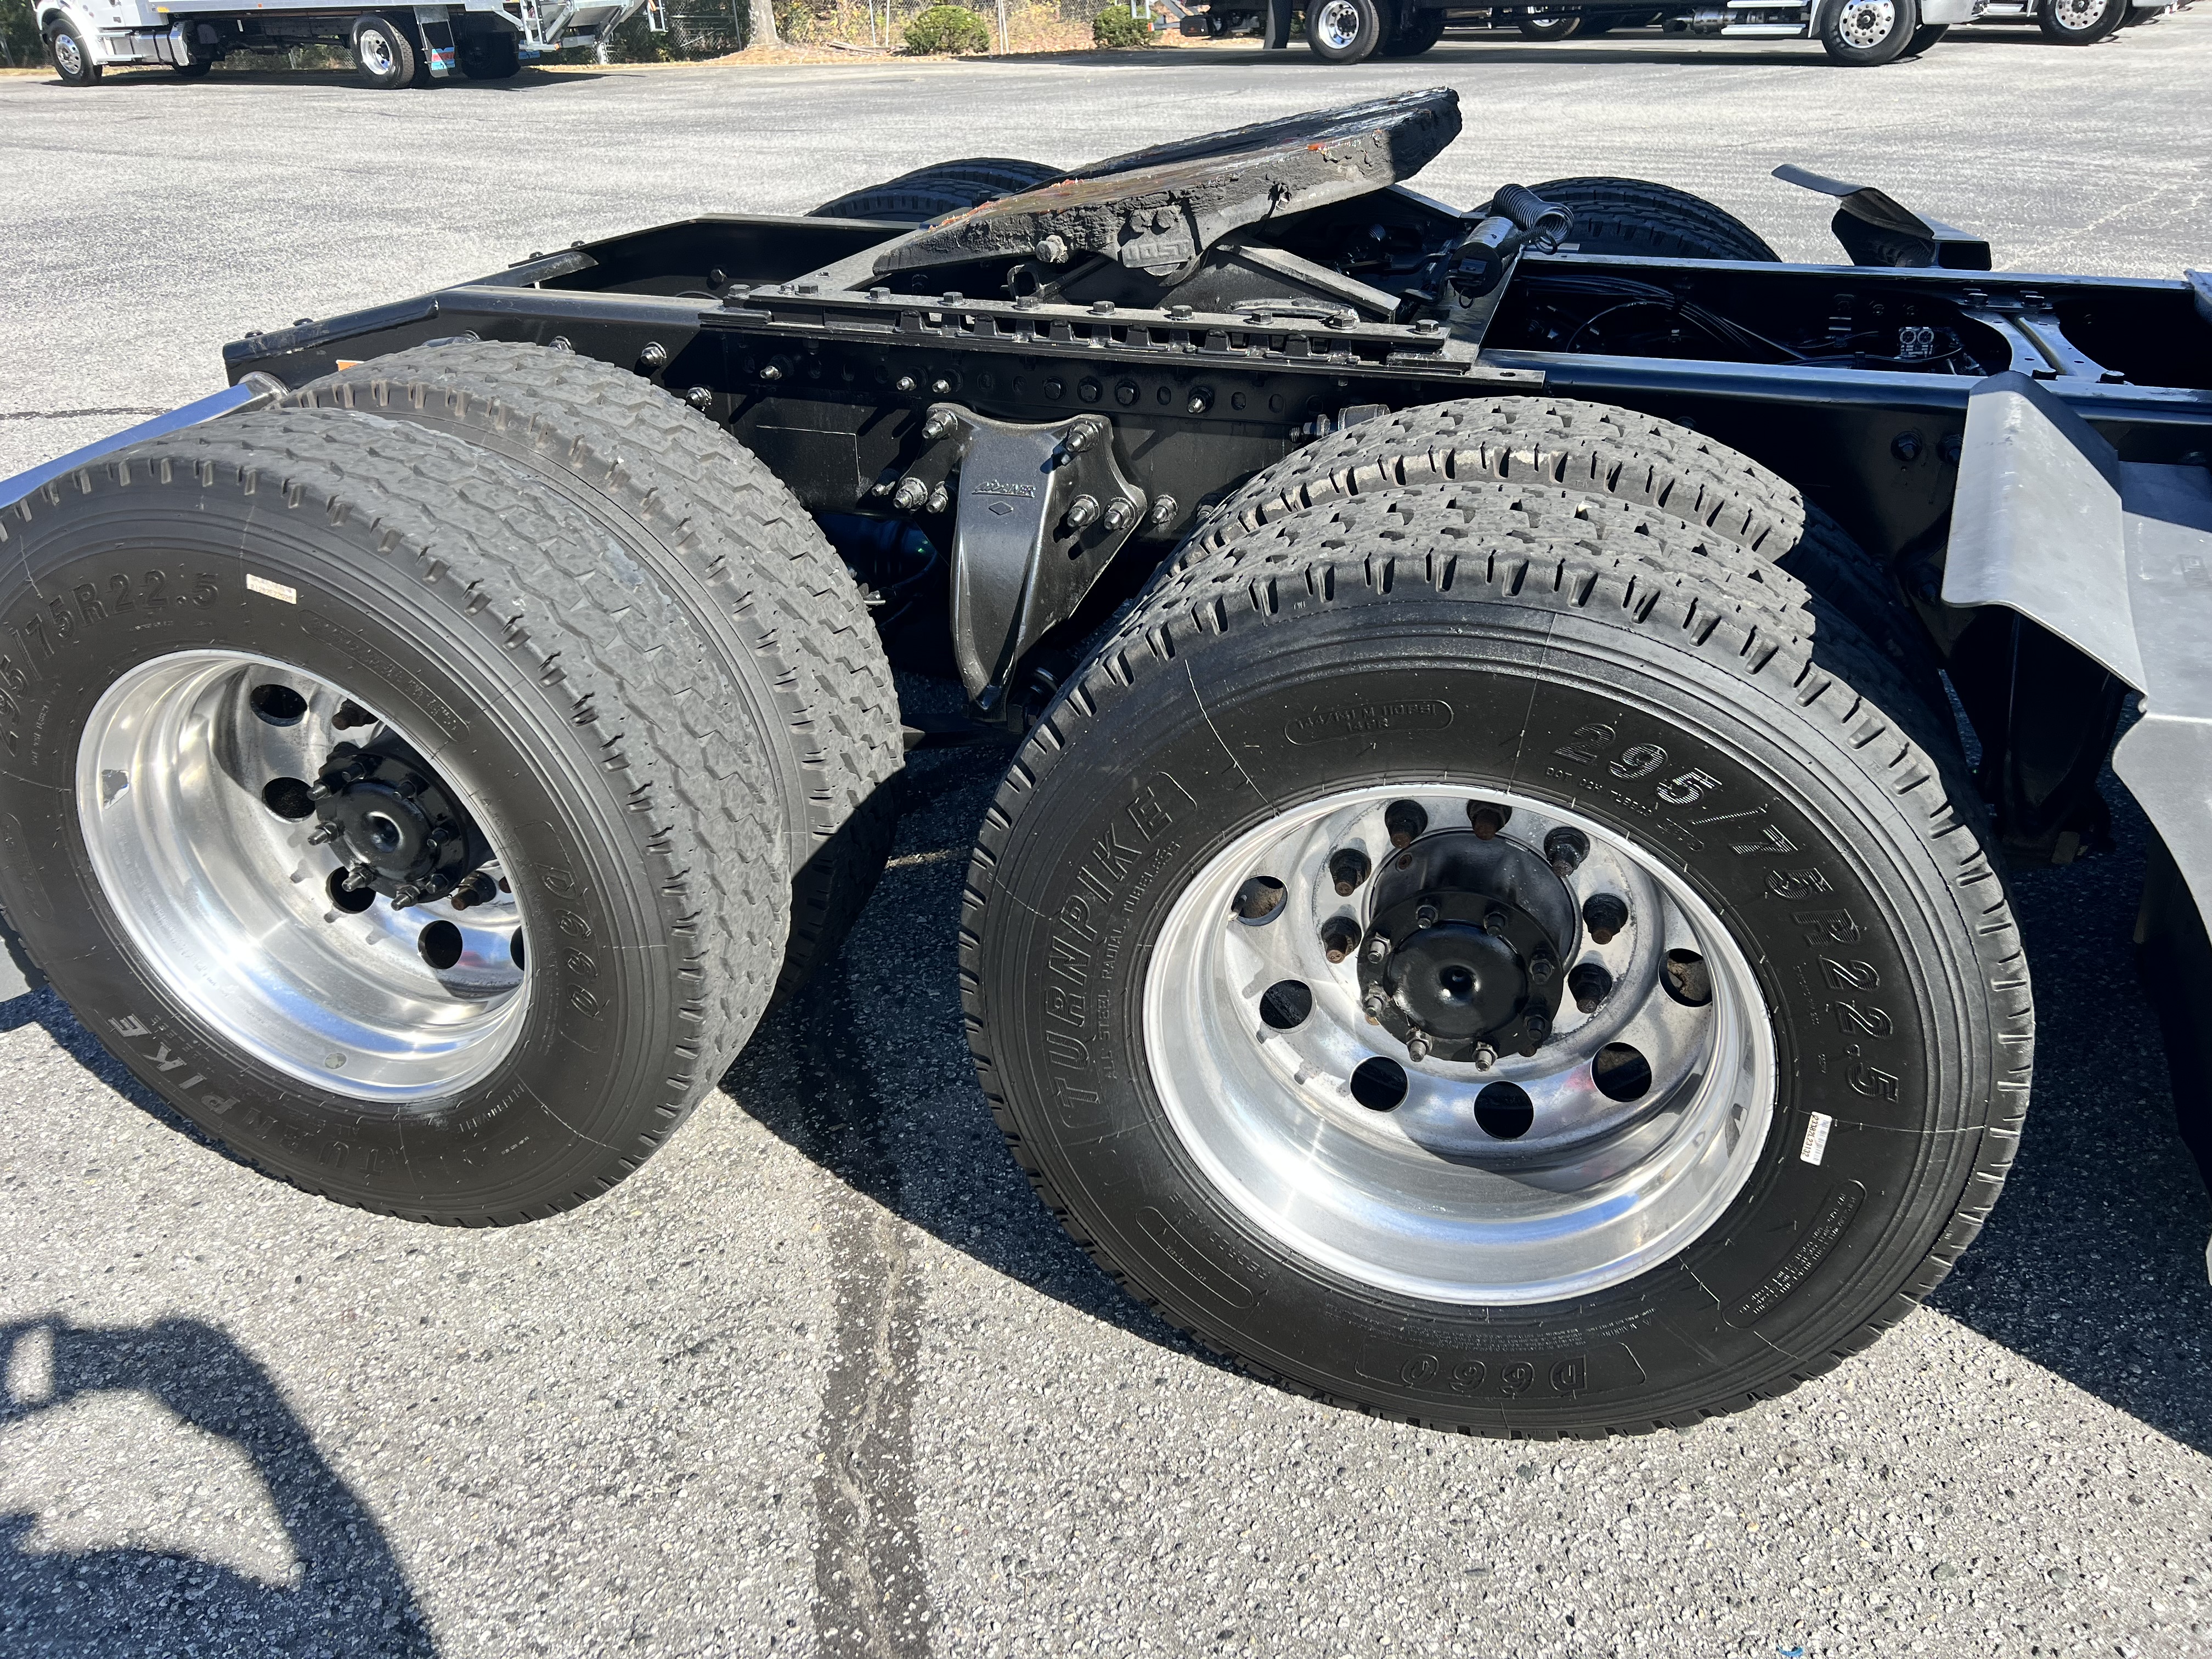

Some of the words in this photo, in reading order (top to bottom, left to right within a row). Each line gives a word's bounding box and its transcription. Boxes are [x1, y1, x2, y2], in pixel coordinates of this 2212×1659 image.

[1126, 239, 1190, 261] JOST
[1546, 766, 1573, 781] DOT
[1122, 840, 1181, 913] TUBELESS
[1551, 723, 1899, 1103] 295/75R22.5
[534, 862, 602, 1020] D660
[1045, 786, 1173, 1108] TURNPIKE
[1101, 925, 1126, 980] RADIAL
[1097, 989, 1111, 1041] STEEL
[1101, 1049, 1118, 1080] ALL
[108, 1014, 384, 1177] TURNPIKE
[1399, 1353, 1588, 1396] D660
